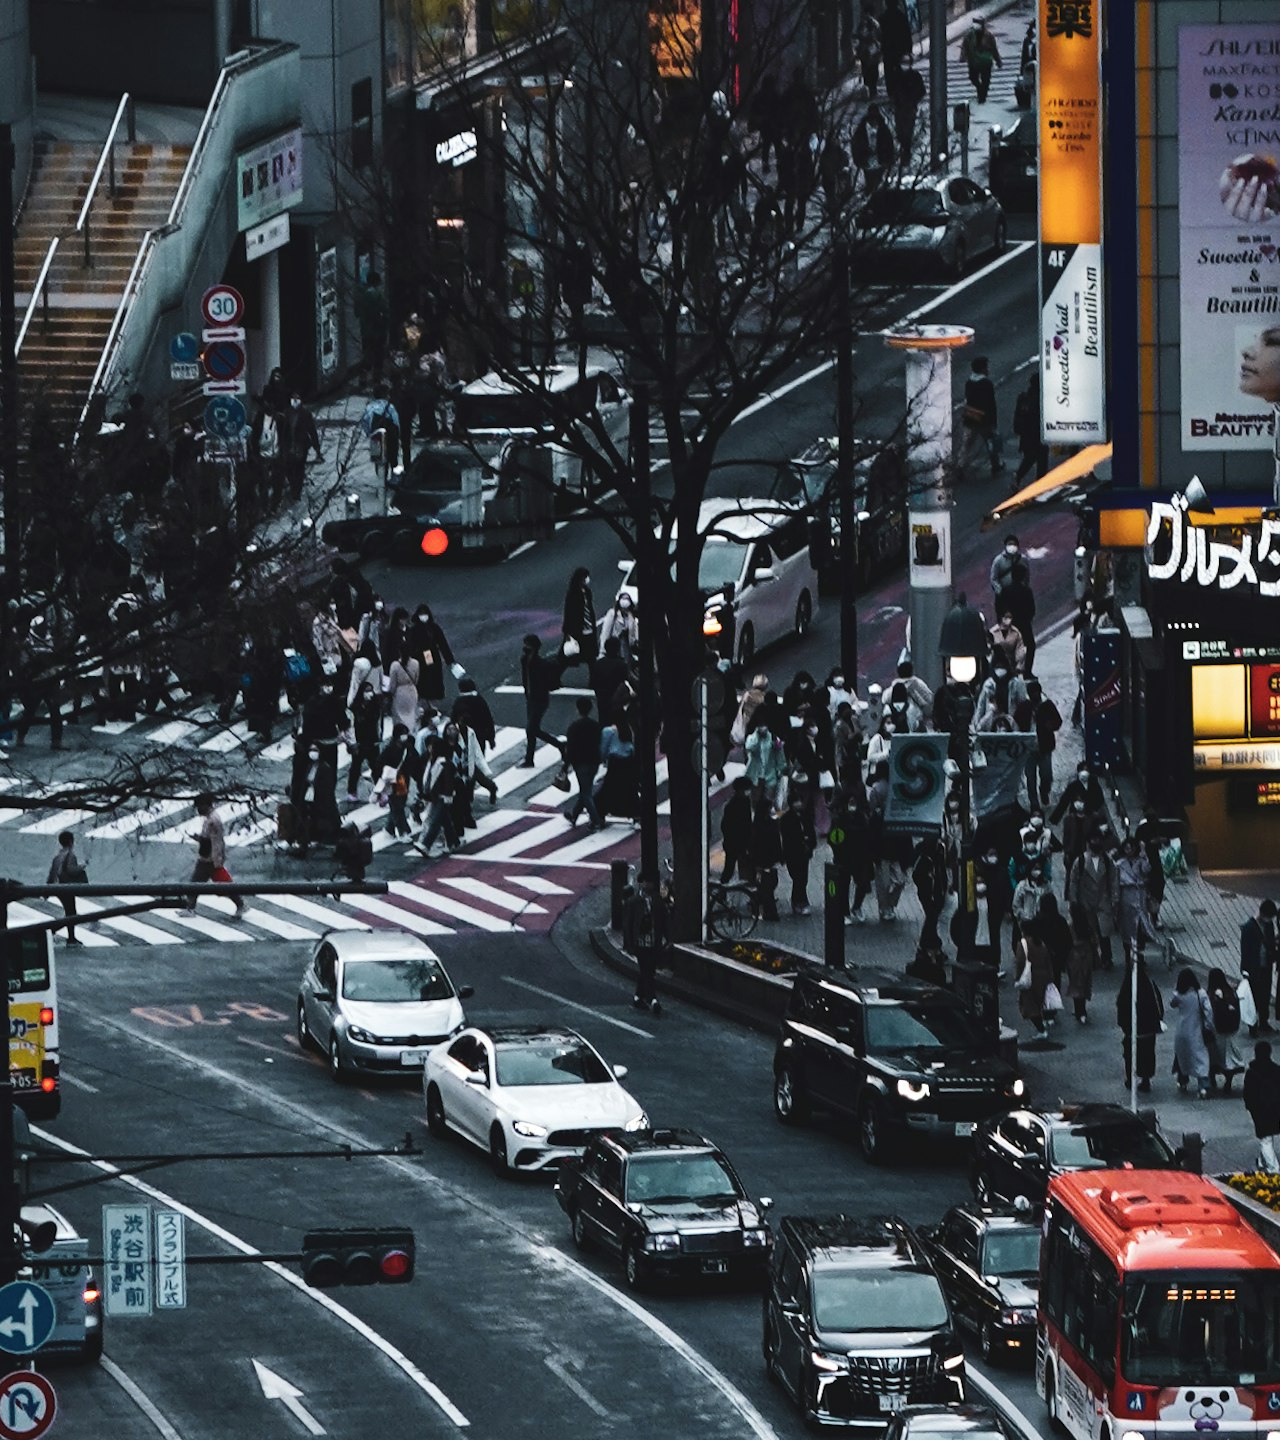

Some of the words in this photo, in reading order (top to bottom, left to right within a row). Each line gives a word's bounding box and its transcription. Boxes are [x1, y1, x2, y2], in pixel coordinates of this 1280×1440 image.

[1047, 248, 1067, 269] 4F
[1197, 247, 1264, 266] Sweetie
[1248, 269, 1261, 284] &
[210, 298, 235, 318] 30
[1084, 265, 1099, 359] Beautilism
[1055, 301, 1070, 338] Nail
[1190, 417, 1264, 438] BEAUTY
[123, 1213, 146, 1308] 渋谷駅前
[163, 1215, 179, 1306] スクランブル式
